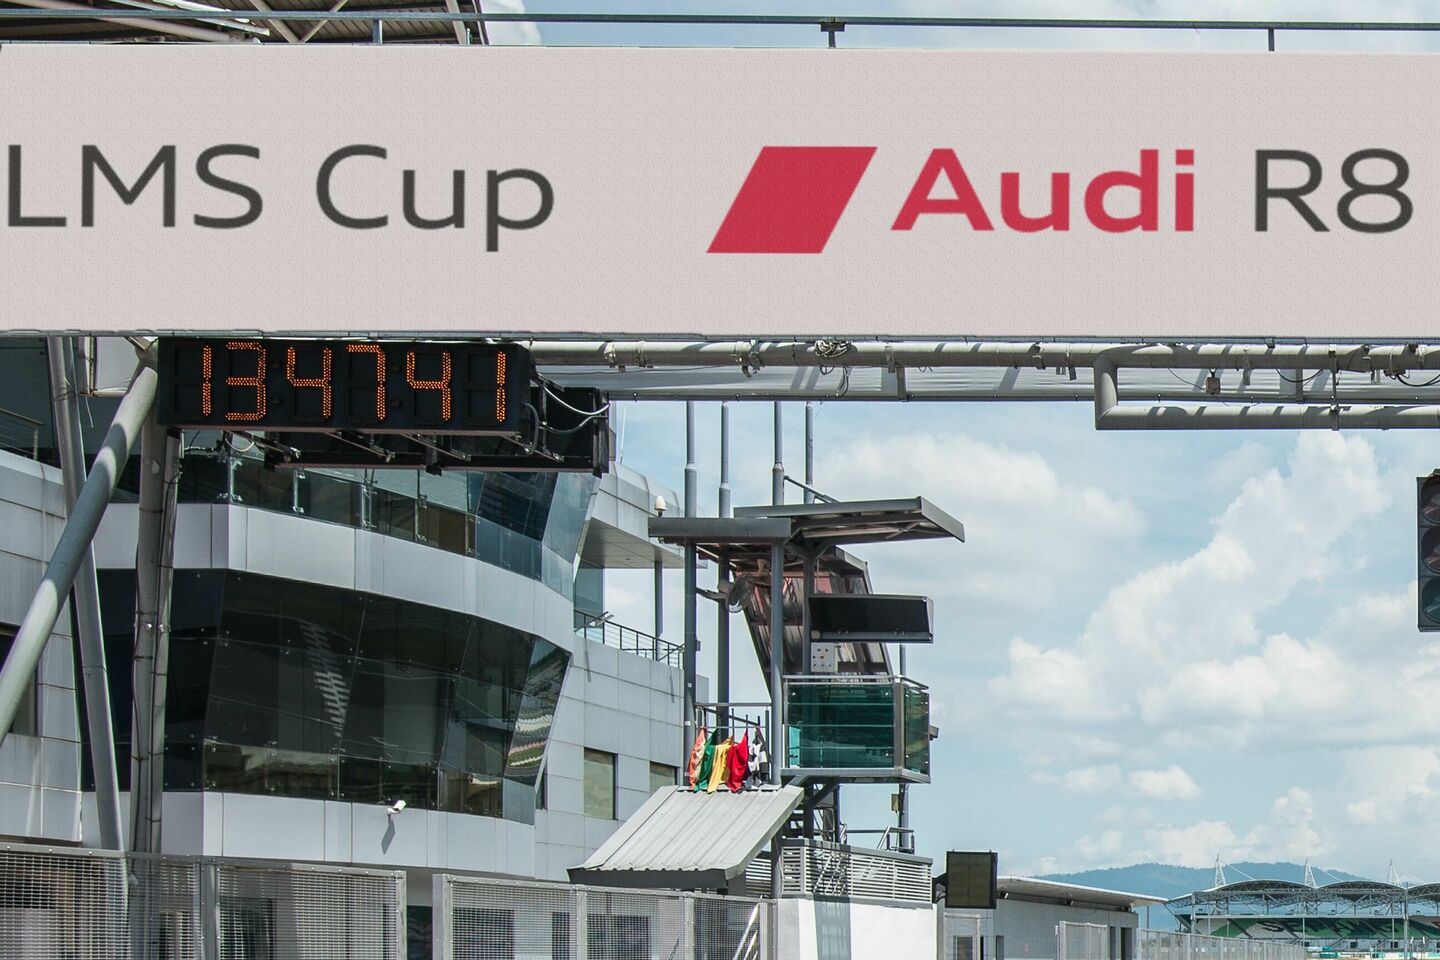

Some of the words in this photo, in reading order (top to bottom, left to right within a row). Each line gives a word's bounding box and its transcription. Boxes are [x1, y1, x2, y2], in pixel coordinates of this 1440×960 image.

[8, 144, 263, 230] LMS
[317, 144, 555, 253] Cup
[890, 146, 1195, 234] Audi
[1255, 149, 1413, 234] R8
